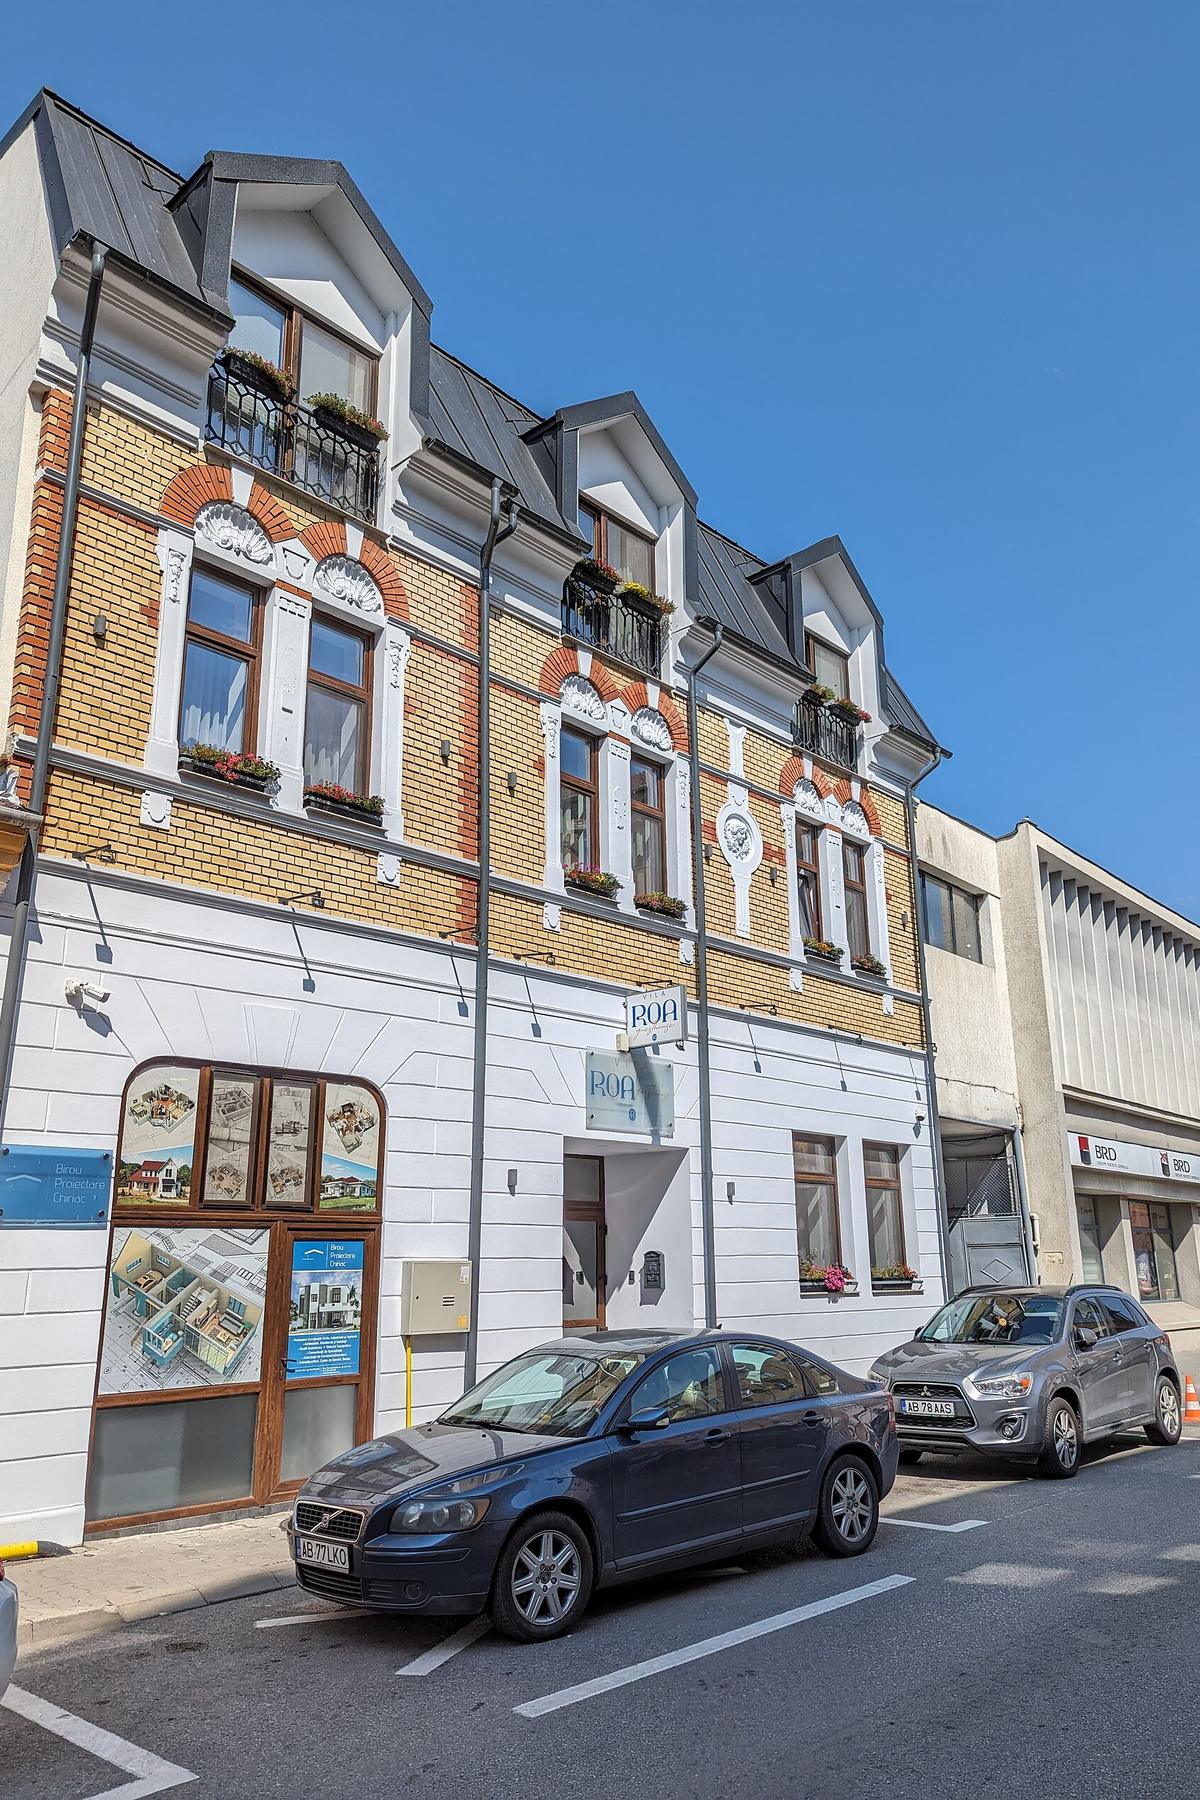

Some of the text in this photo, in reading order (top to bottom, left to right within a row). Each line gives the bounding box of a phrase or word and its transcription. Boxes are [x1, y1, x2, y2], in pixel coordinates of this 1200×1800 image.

[643, 991, 665, 1000] VILA
[632, 999, 677, 1028] ROA
[590, 1070, 636, 1100] ROA
[1094, 1144, 1117, 1161] BRD
[55, 1163, 82, 1174] Birou
[1173, 1158, 1191, 1173] BRD
[54, 1178, 105, 1190] Proiectare
[53, 1192, 86, 1204] Chiriac
[330, 1243, 344, 1251] Birou
[907, 1401, 952, 1414] AB 78 AAS
[302, 1541, 313, 1558] AB
